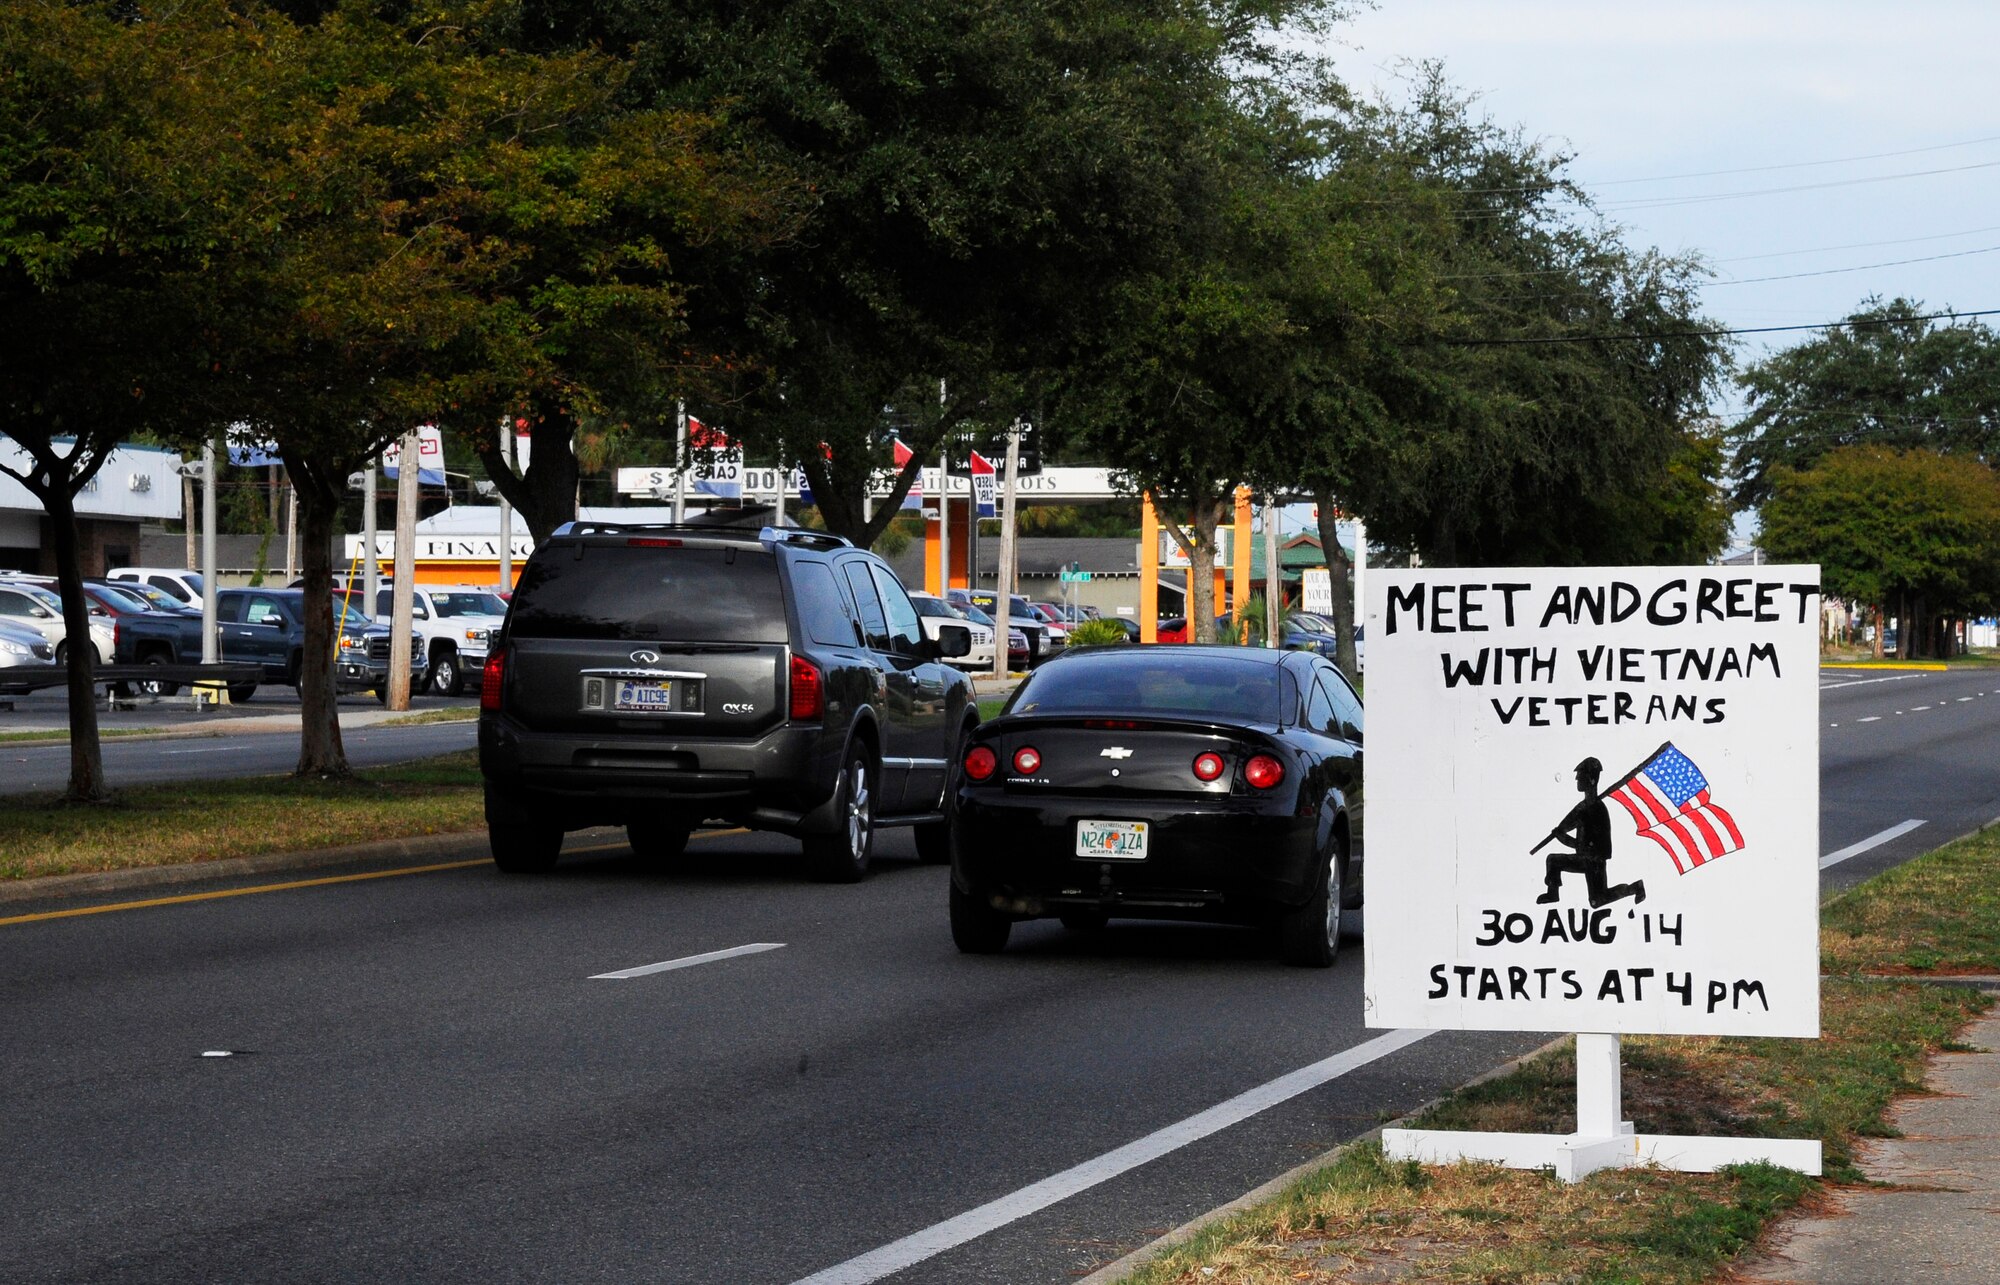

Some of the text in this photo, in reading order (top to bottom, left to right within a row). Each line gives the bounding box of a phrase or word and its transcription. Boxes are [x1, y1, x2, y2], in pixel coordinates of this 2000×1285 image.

[1386, 583, 1531, 635] MEET
[1441, 643, 1781, 688] WITH VIETNAM
[722, 703, 754, 714] QX56
[1491, 692, 1726, 727] VETERANS
[1476, 910, 1534, 947] 30
[1541, 908, 1618, 945] AUG
[1429, 964, 1582, 1000] STARTS
[1597, 967, 1655, 1004] AT
[1667, 971, 1692, 1006] 4
